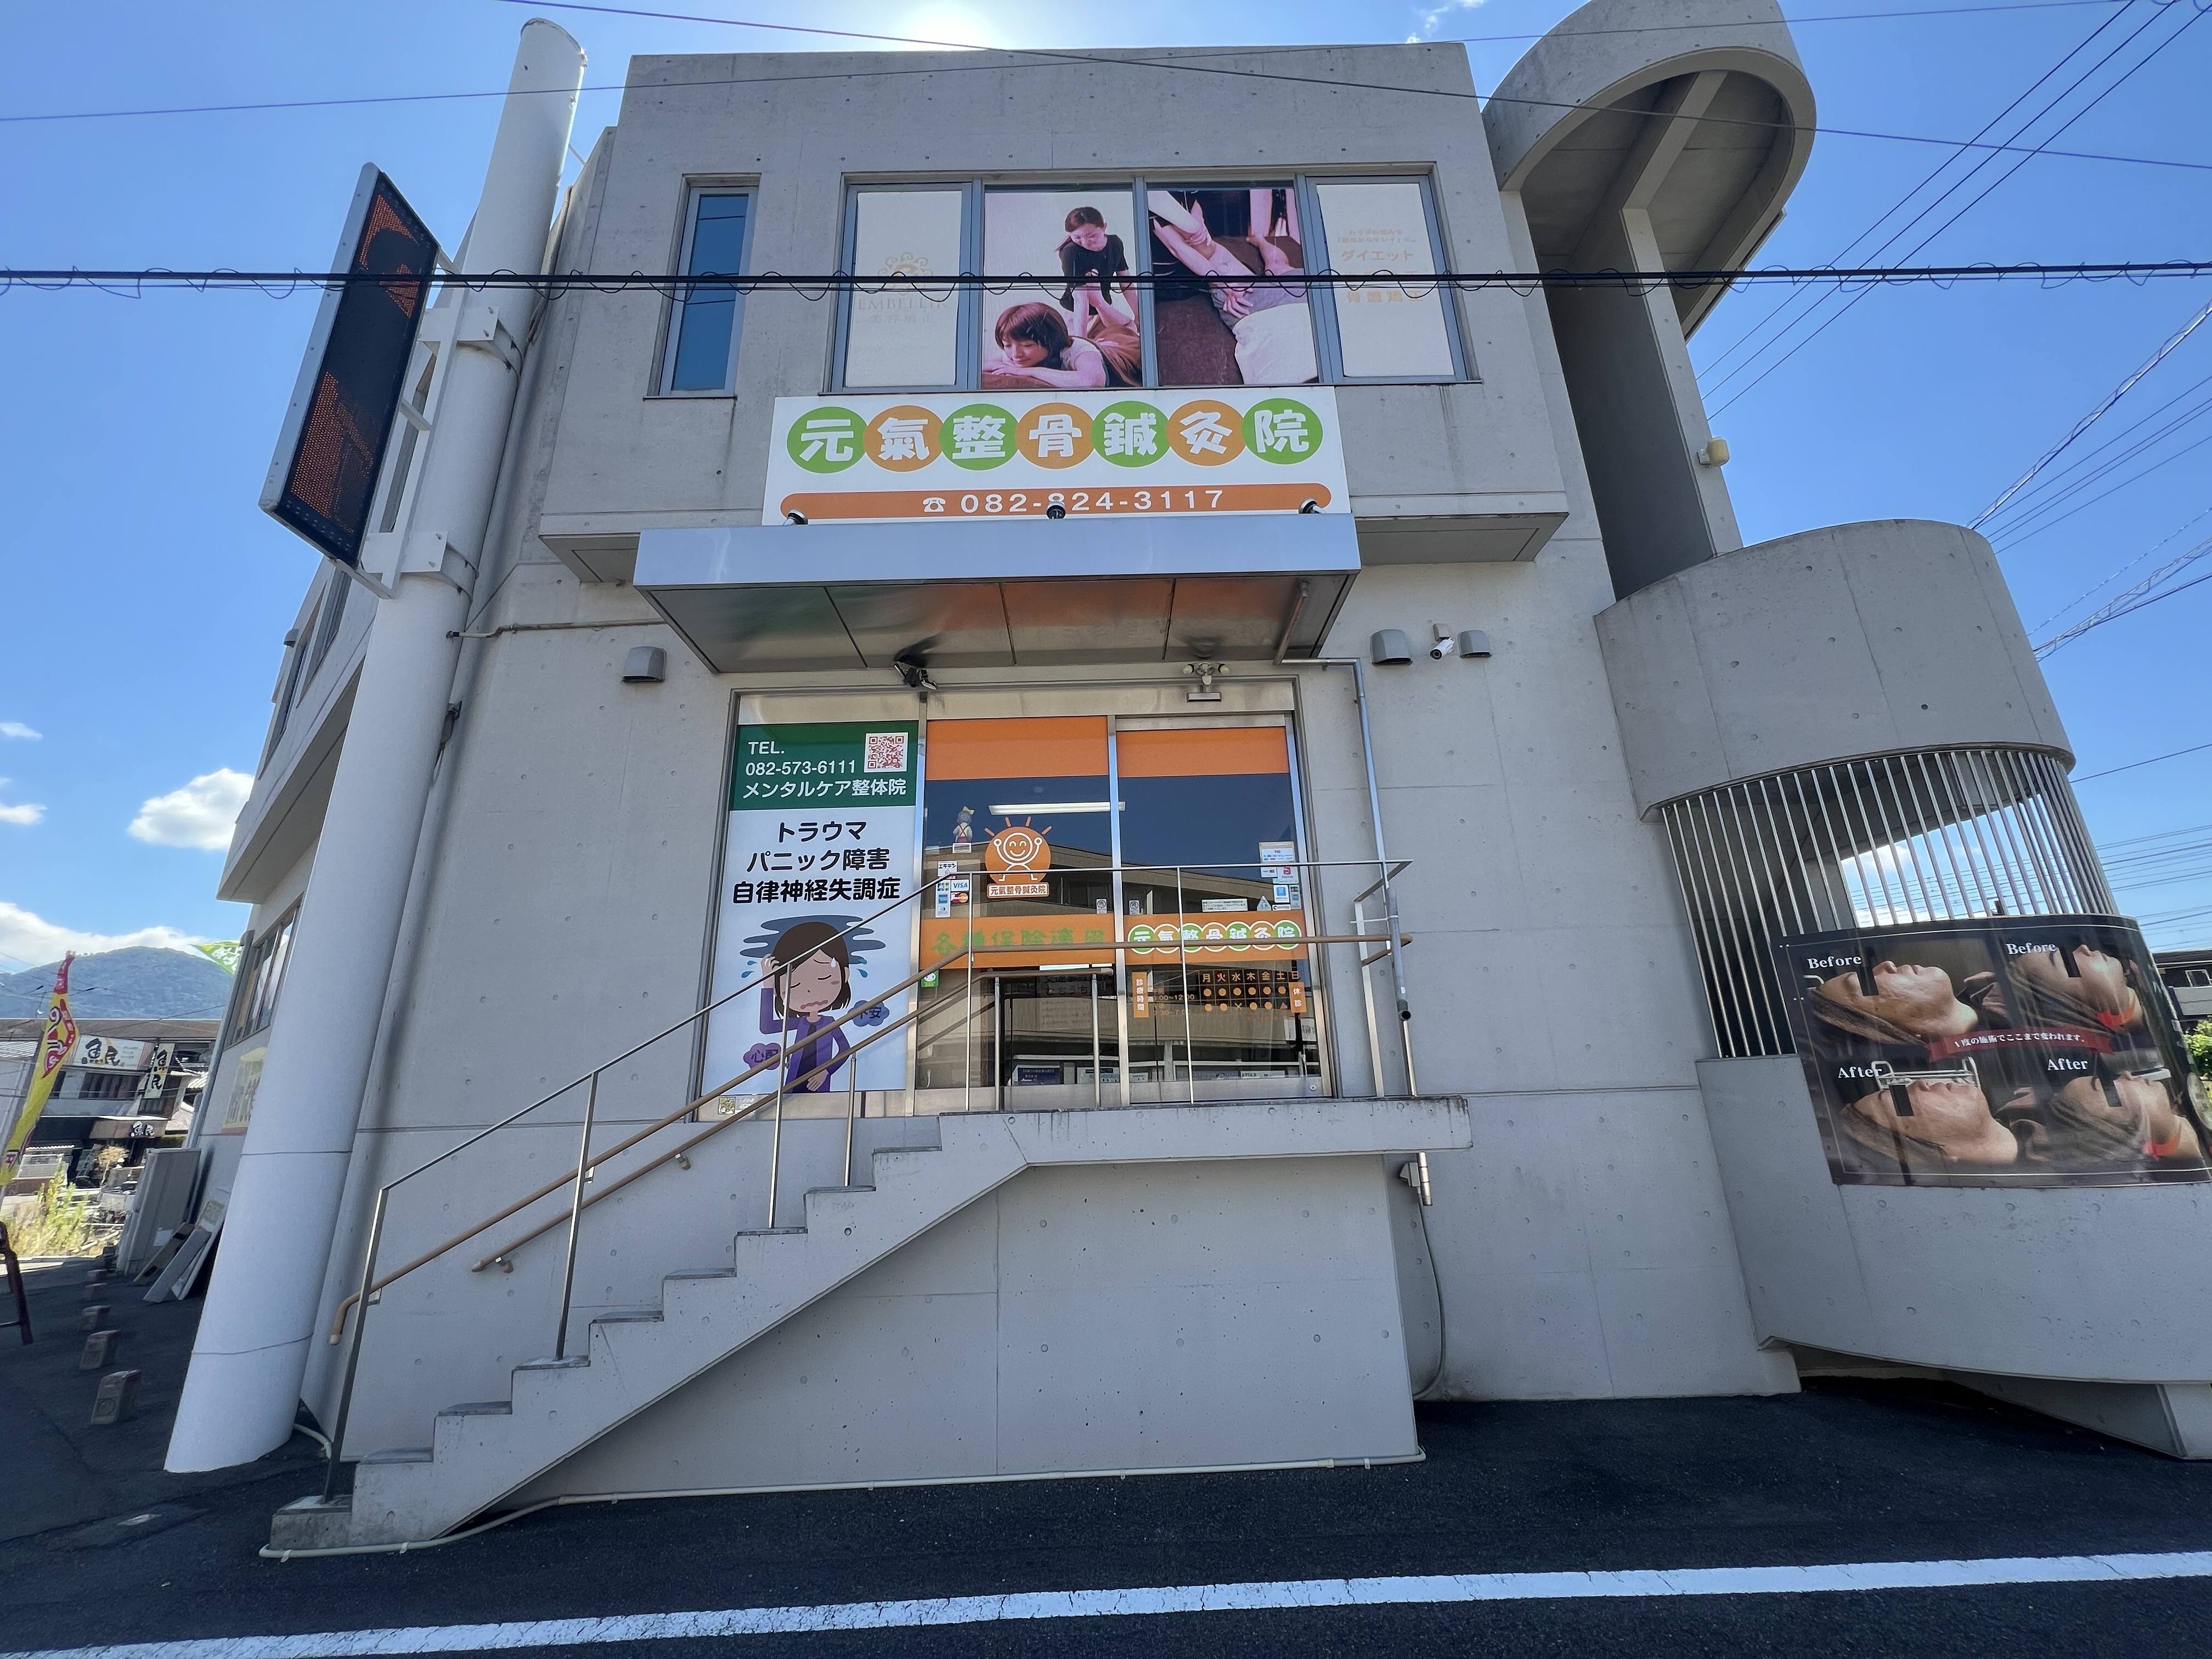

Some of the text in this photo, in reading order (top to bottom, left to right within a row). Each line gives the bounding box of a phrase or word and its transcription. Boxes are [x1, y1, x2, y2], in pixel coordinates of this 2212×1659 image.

[1341, 249, 1414, 262] ダイエット
[800, 410, 1309, 463] 元氣整骨鍼灸院
[961, 490, 1222, 514] 082-824-3117
[748, 741, 785, 755] TEL.
[745, 760, 856, 776] 082-573-6111
[742, 778, 907, 799] メンタルケア整体院
[778, 821, 867, 843] トラウマ
[746, 847, 890, 873] パニック障害
[732, 877, 901, 904] 自律神経失調症
[2006, 941, 2057, 956] Before
[1807, 954, 1863, 970] Before
[1202, 971, 1300, 983] 月 火 水 木 金 土 日
[2046, 1057, 2089, 1071] After
[1837, 1065, 1883, 1080] After
